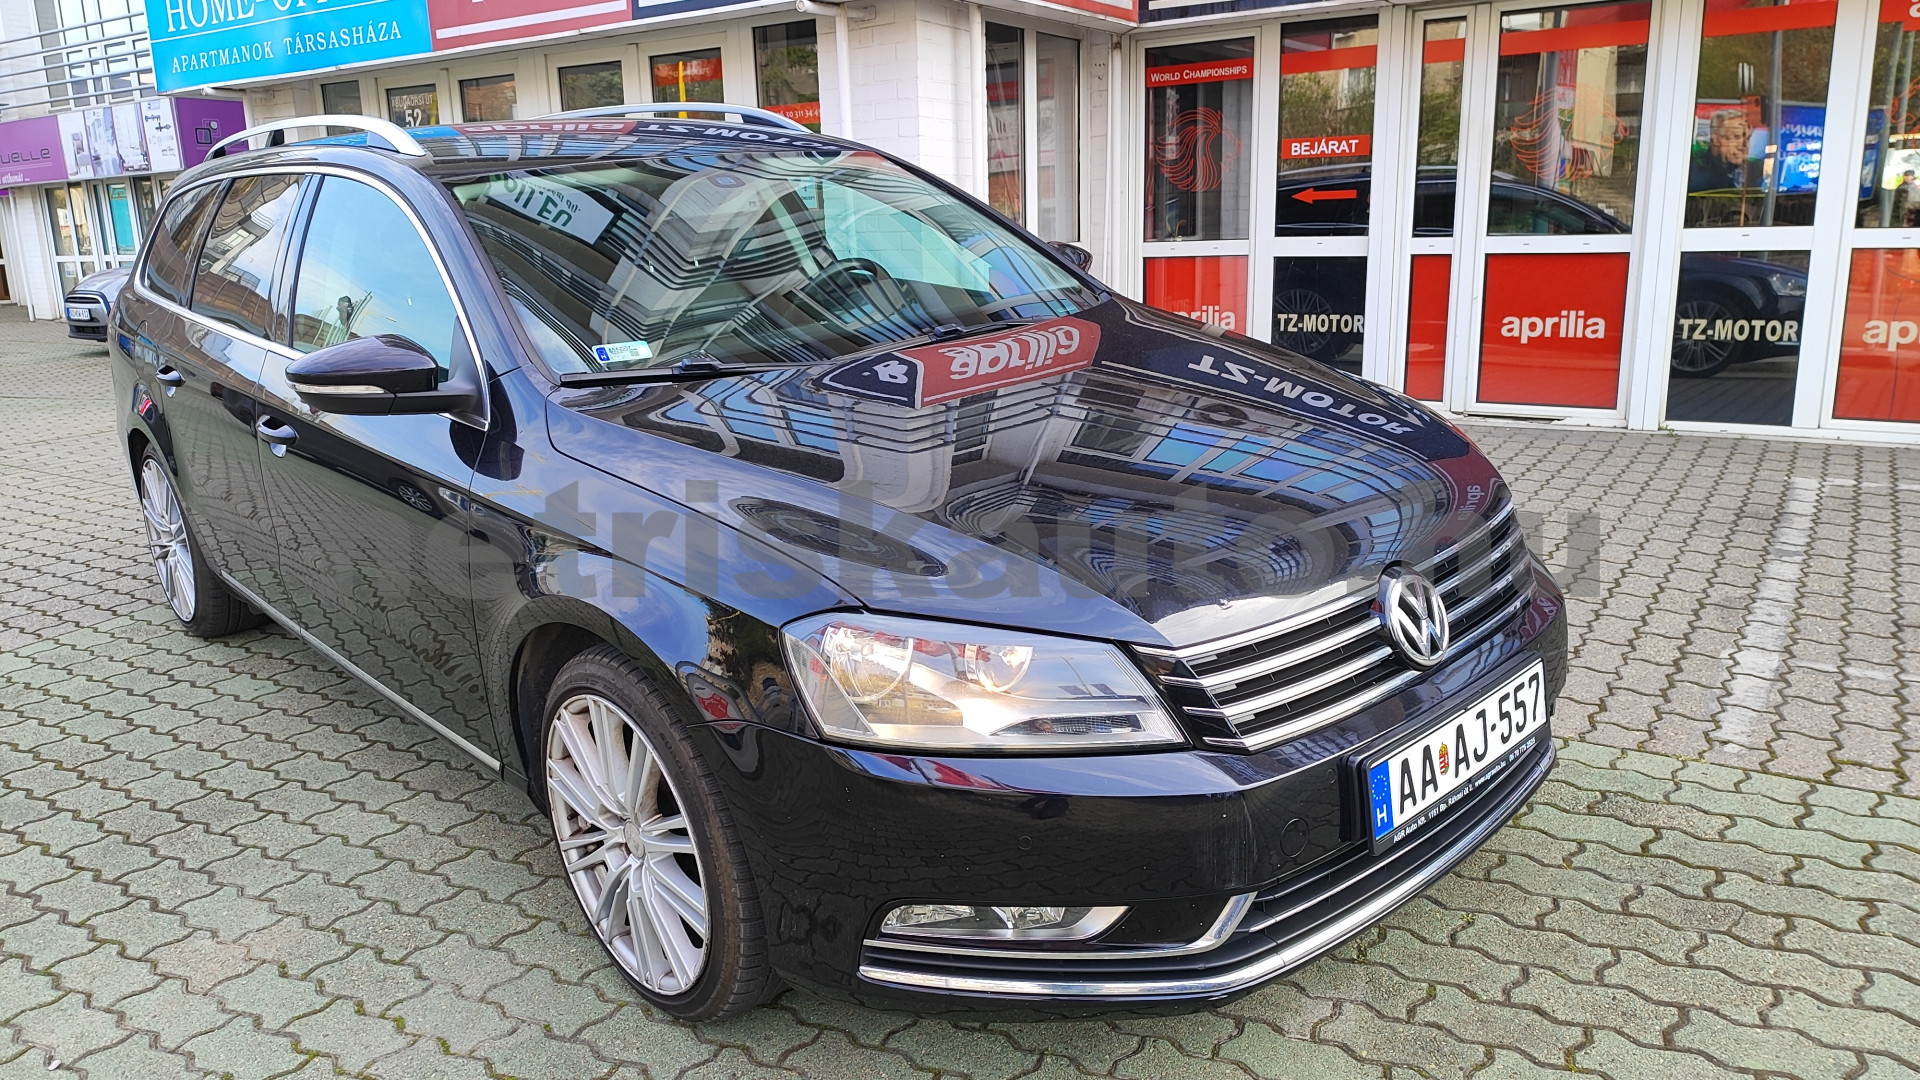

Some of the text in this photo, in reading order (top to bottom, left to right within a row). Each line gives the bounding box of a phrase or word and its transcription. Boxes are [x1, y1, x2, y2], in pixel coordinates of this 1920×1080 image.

[171, 20, 402, 74] APARTMANOK TÁRSASHÁZA
[405, 108, 422, 127] 52
[1290, 138, 1360, 156] BEJÁRAT
[1277, 313, 1364, 333] TZ-MOTOR
[1500, 310, 1606, 344] aprilia
[1678, 318, 1799, 342] TZ-MOTOR
[1862, 320, 1920, 352] ap
[1376, 803, 1388, 828] H
[1399, 744, 1439, 815] AA
